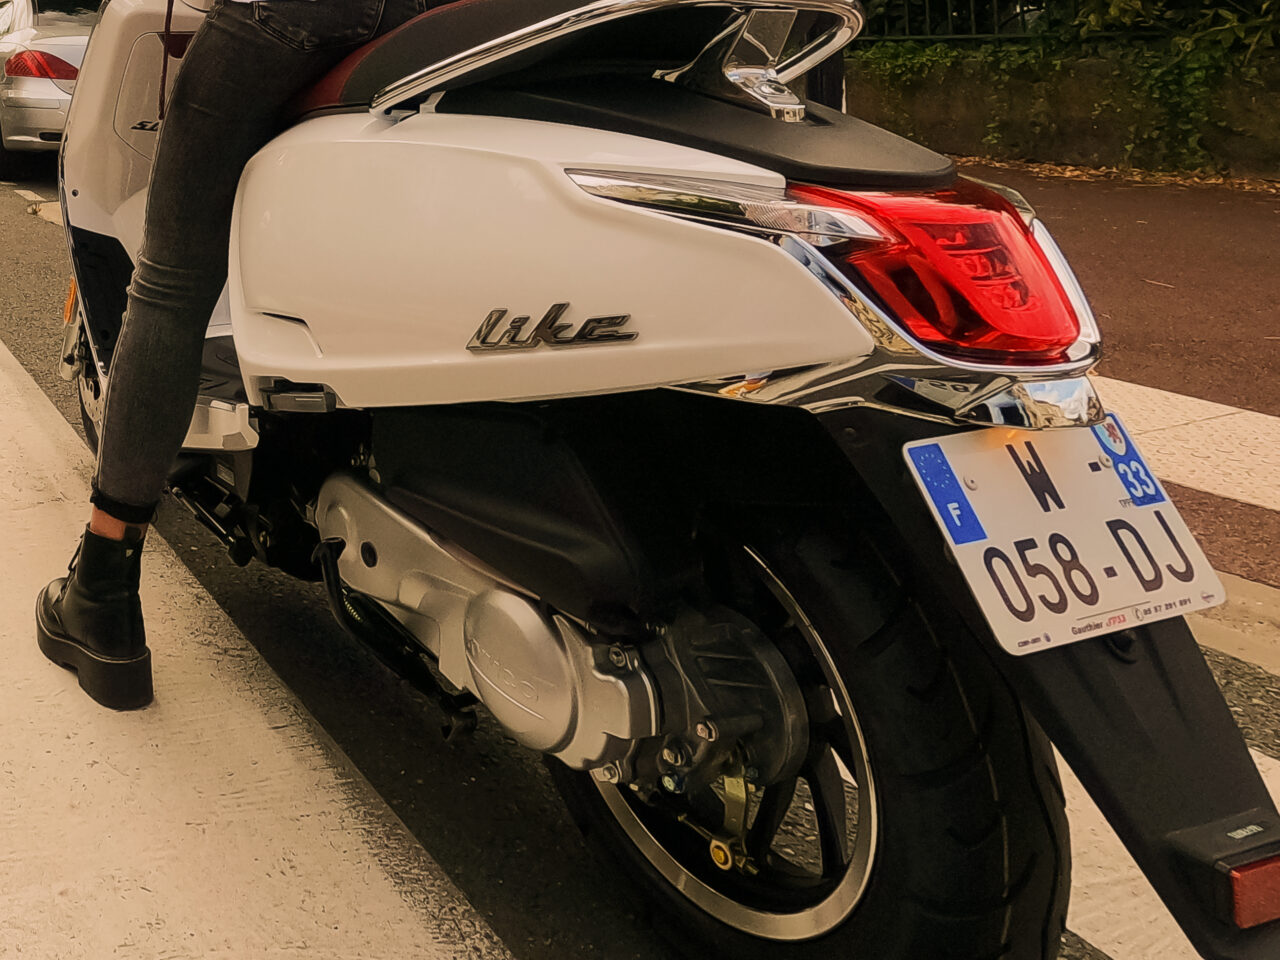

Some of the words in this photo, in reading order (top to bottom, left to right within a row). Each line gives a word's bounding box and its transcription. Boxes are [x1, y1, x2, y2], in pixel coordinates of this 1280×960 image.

[1117, 460, 1157, 498] 33
[946, 502, 962, 527] F
[1071, 620, 1103, 636] Gauthier
